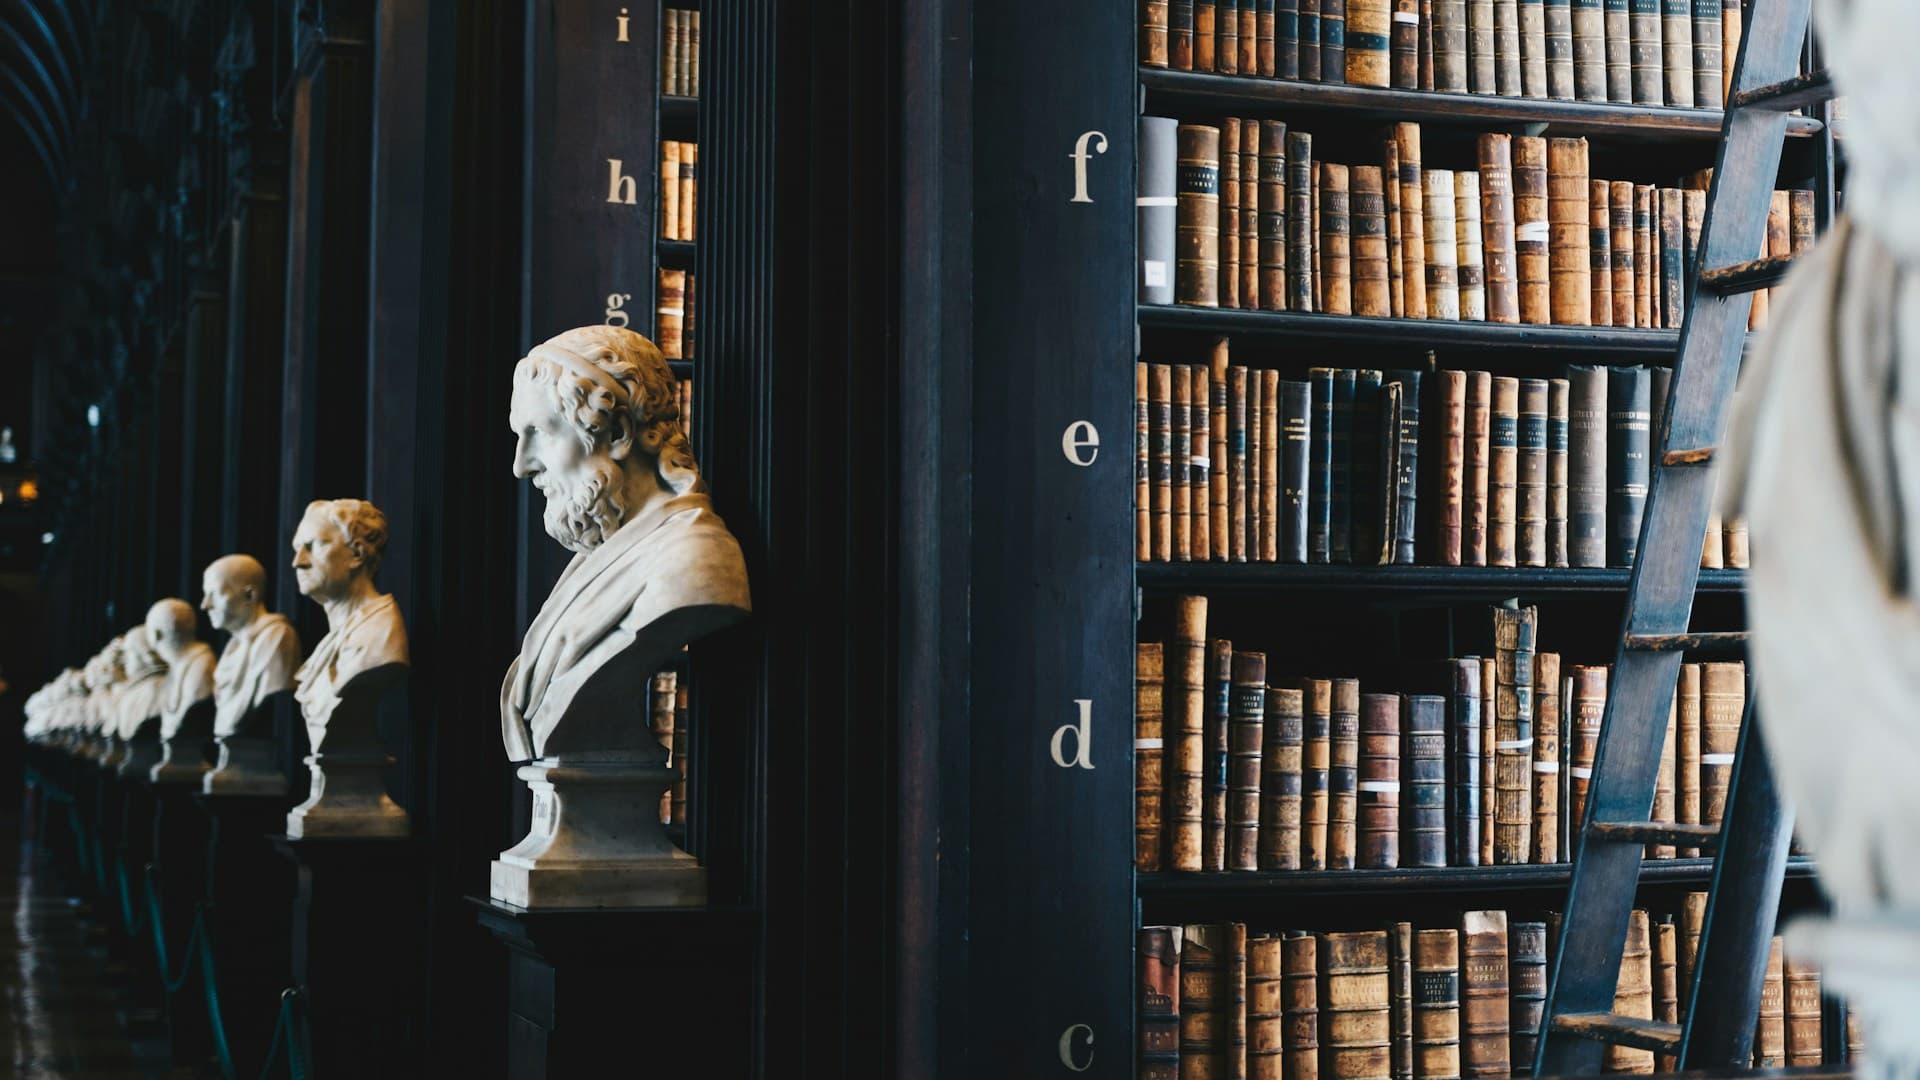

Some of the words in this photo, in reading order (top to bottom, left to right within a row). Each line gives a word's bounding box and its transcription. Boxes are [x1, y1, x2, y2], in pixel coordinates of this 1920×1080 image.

[616, 7, 630, 42] i
[605, 158, 638, 205] h
[1068, 130, 1109, 203] f
[605, 292, 632, 327] g
[1062, 420, 1100, 467] e
[1050, 698, 1096, 770] d
[1059, 1023, 1094, 1071] c
